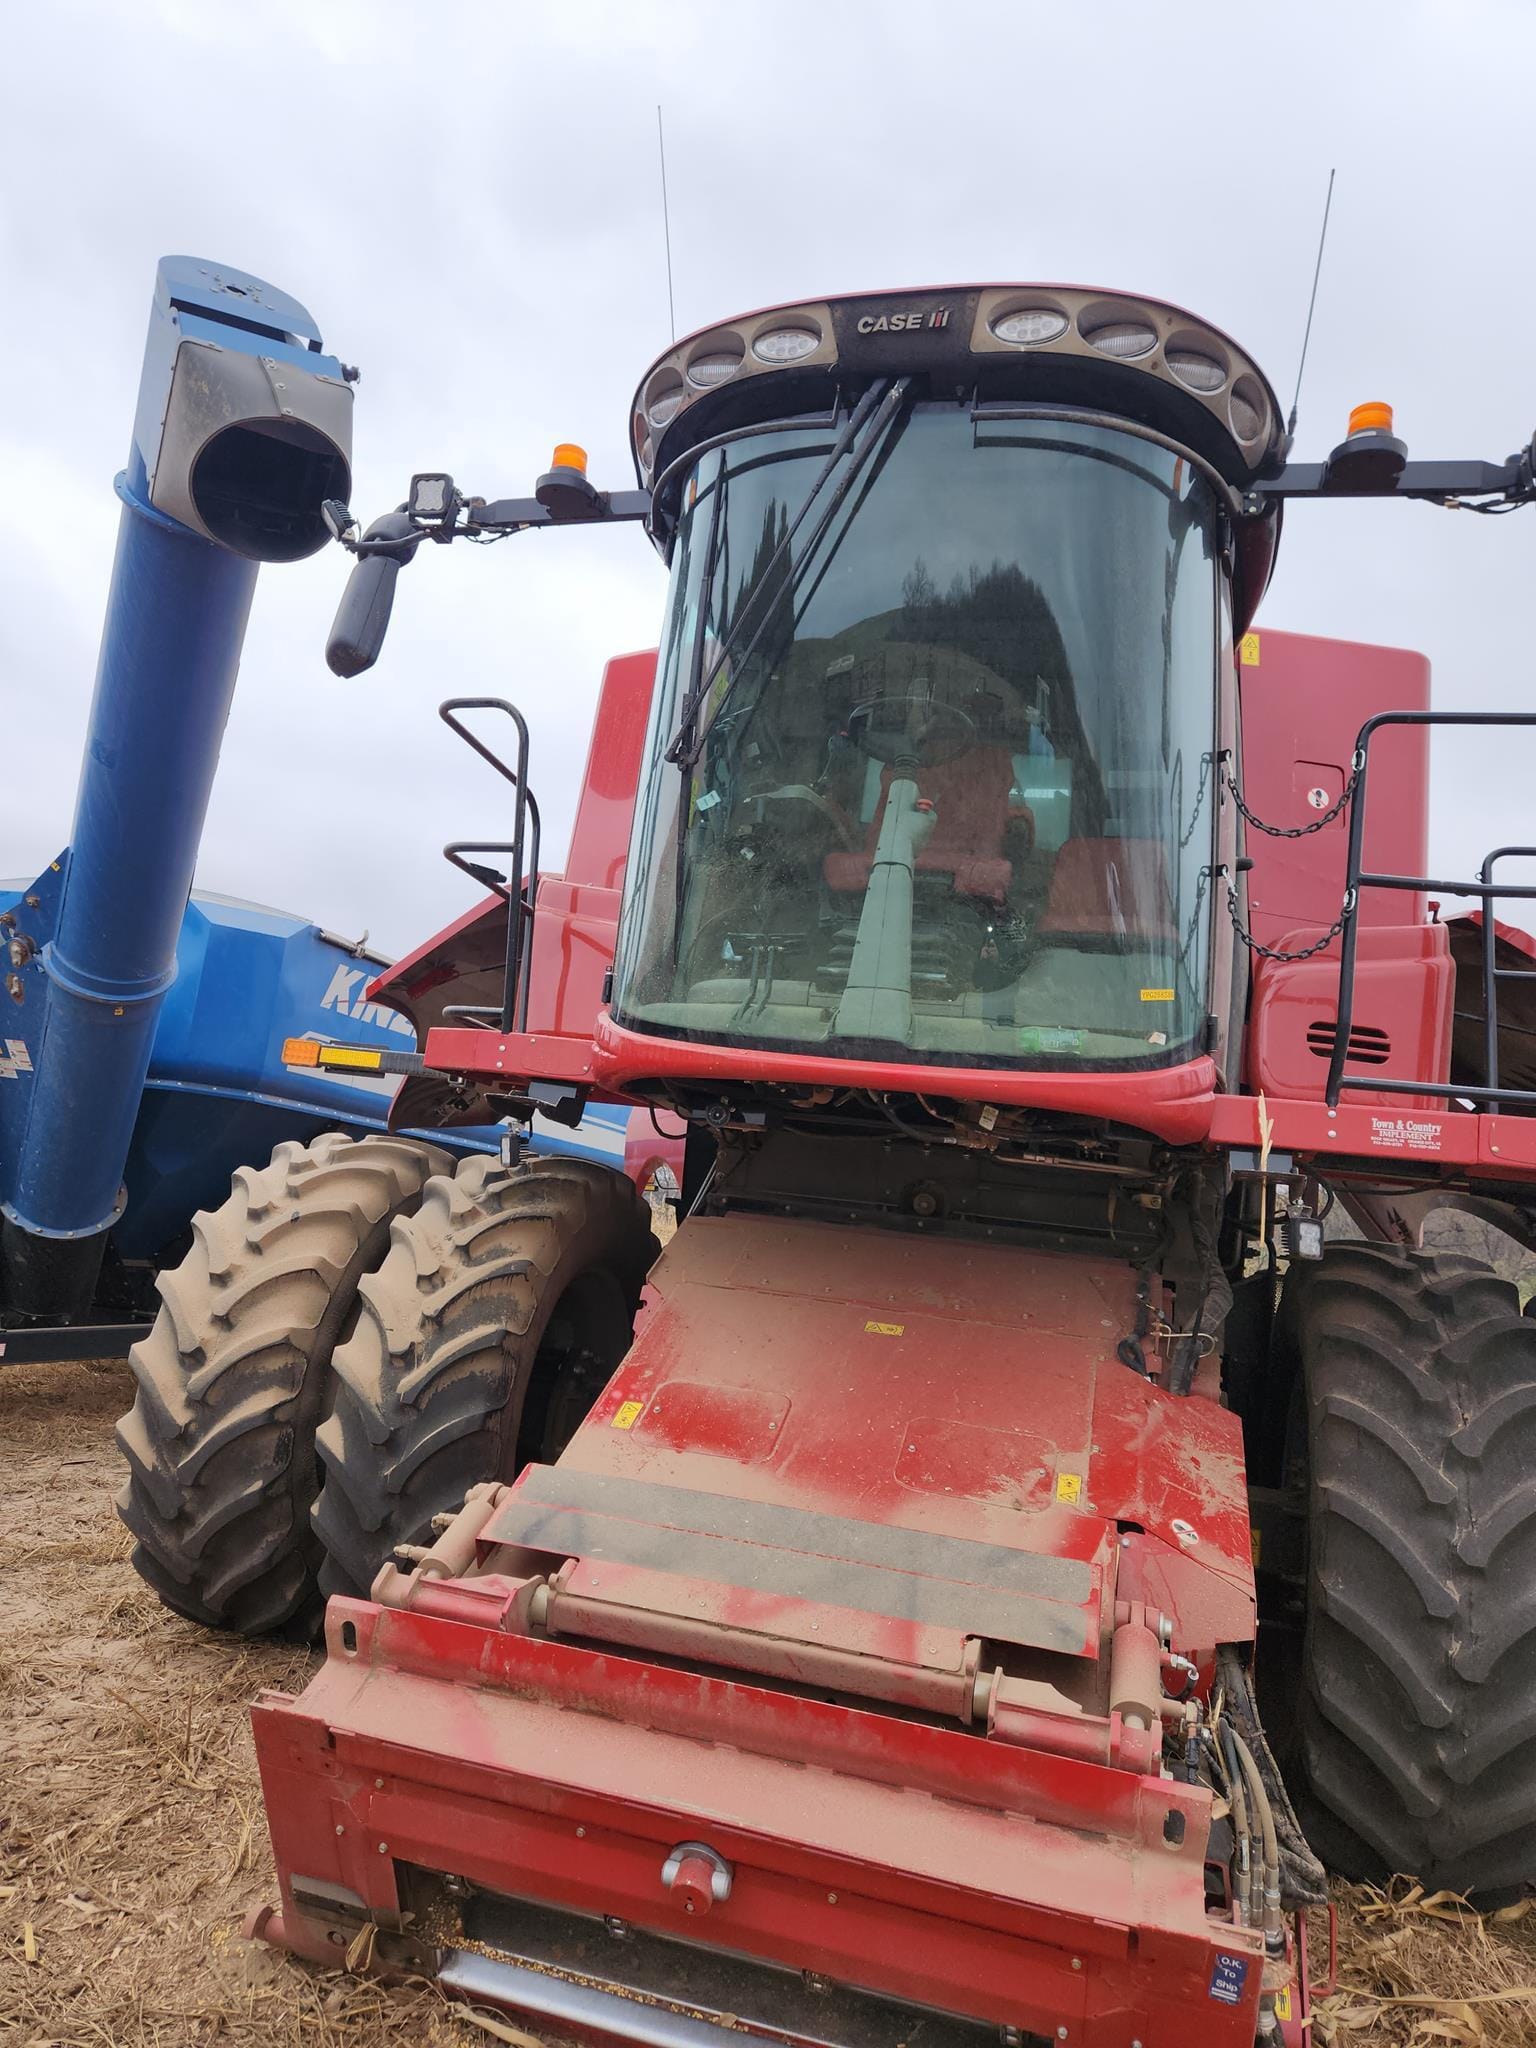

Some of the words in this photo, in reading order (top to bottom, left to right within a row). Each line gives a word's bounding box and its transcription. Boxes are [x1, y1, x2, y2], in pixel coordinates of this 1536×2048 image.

[858, 314, 923, 333] CASE
[1372, 1118, 1394, 1128] Town
[1396, 1119, 1405, 1130] &
[1406, 1121, 1441, 1133] Country
[1379, 1130, 1434, 1141] IMPLEMENT
[1221, 1956, 1242, 1969] O.K.
[1222, 1967, 1236, 1978] To
[1215, 1979, 1238, 1992] Ship
